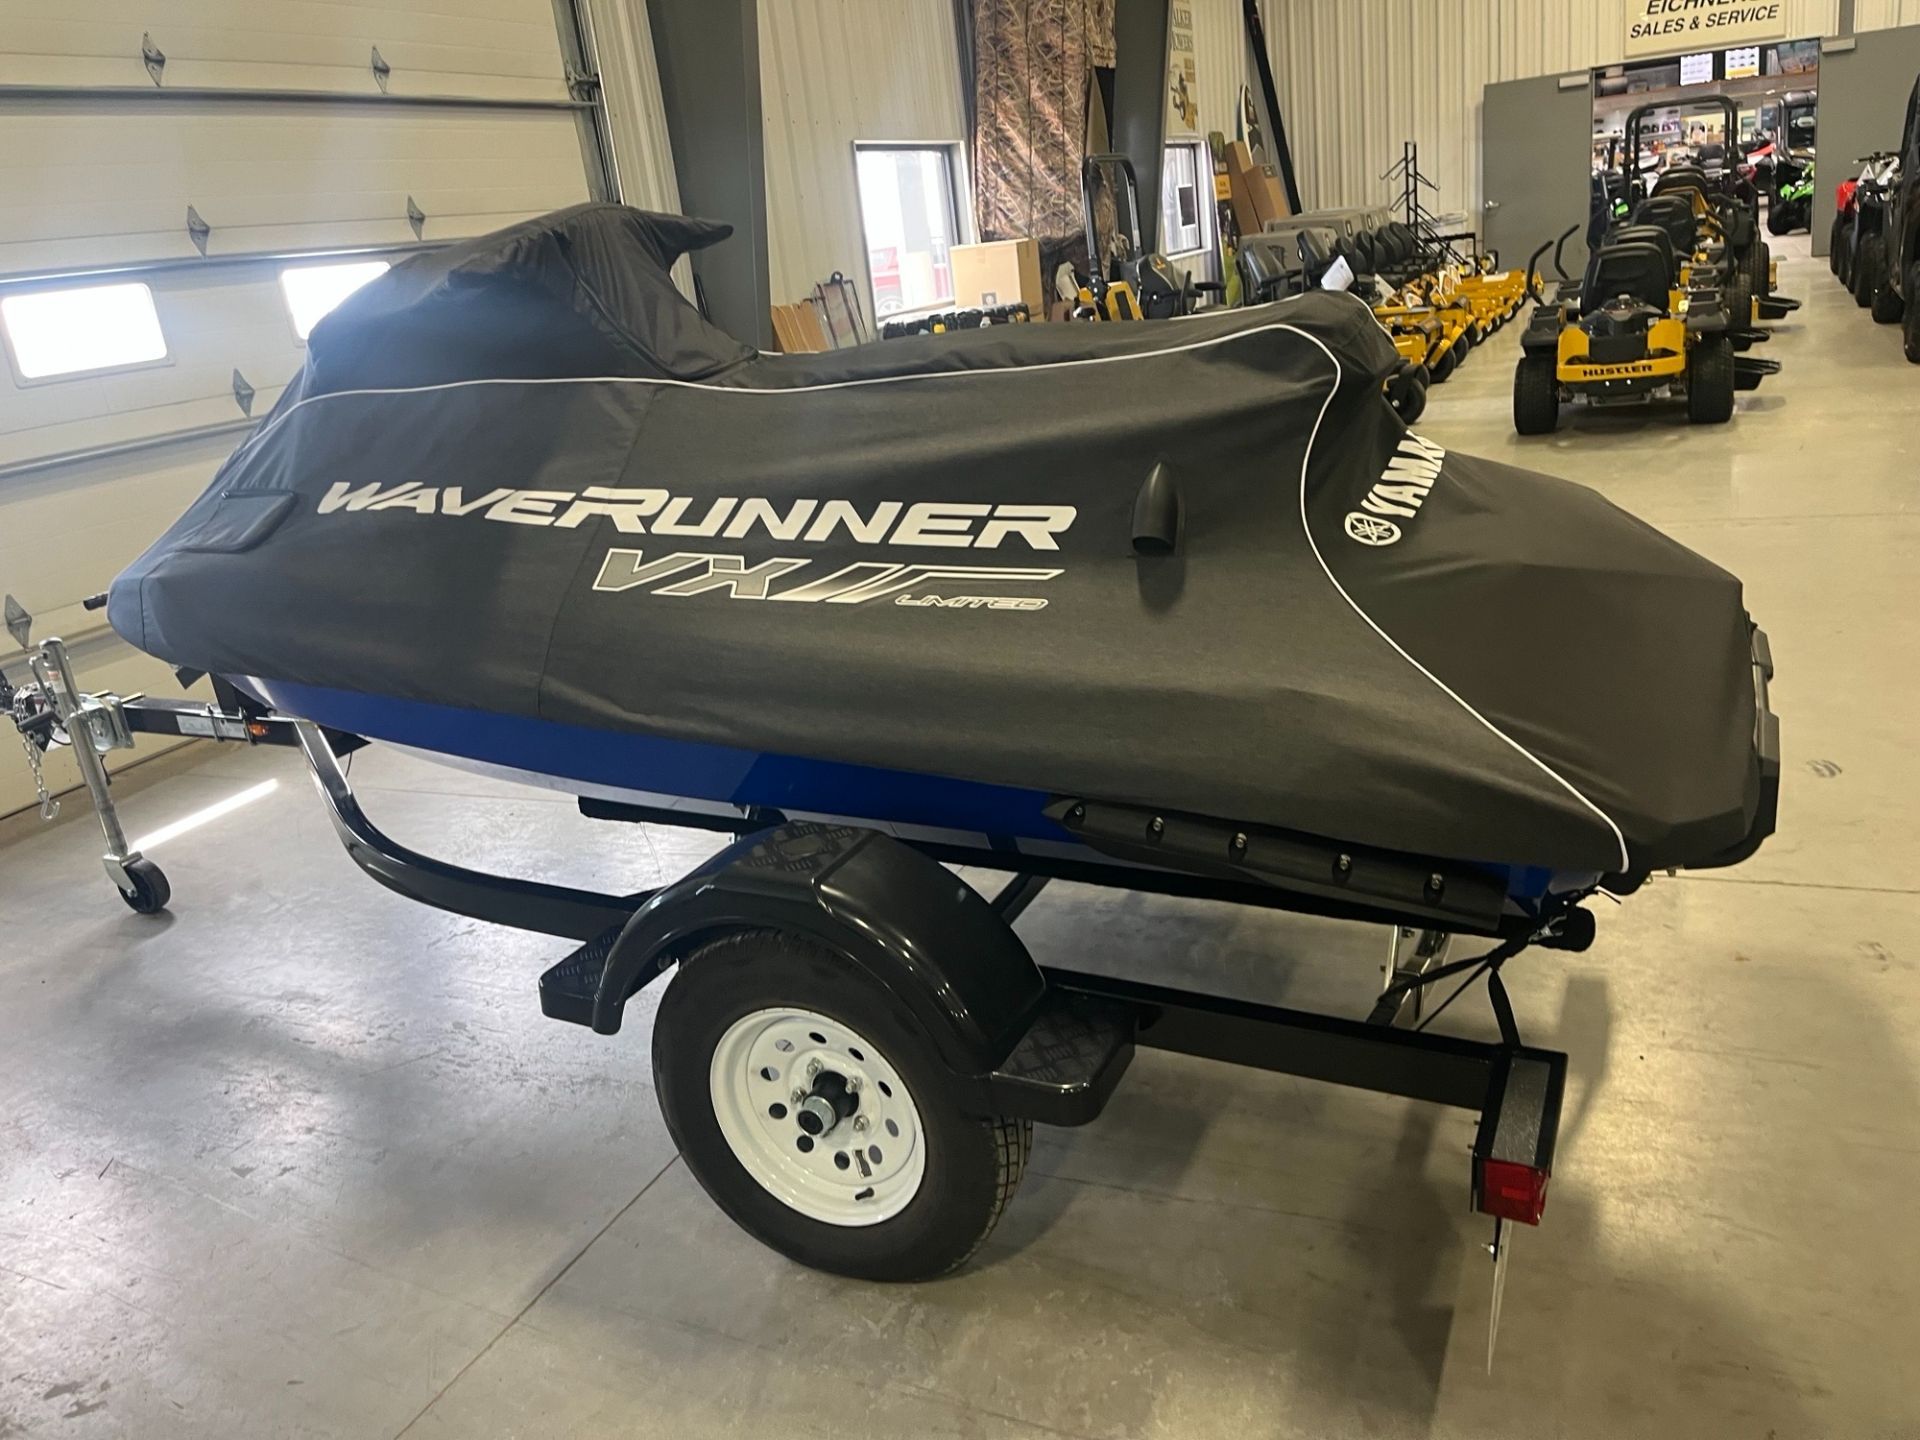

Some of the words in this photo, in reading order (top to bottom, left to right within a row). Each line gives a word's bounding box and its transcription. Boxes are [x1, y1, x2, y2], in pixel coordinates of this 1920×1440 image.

[1630, 17, 1685, 38] SALES
[1689, 15, 1700, 30] &
[1705, 4, 1780, 28] SERVICE
[1582, 364, 1653, 377] HUSTLER
[1360, 429, 1446, 519] YAMA
[895, 594, 1049, 611] LIMITED
